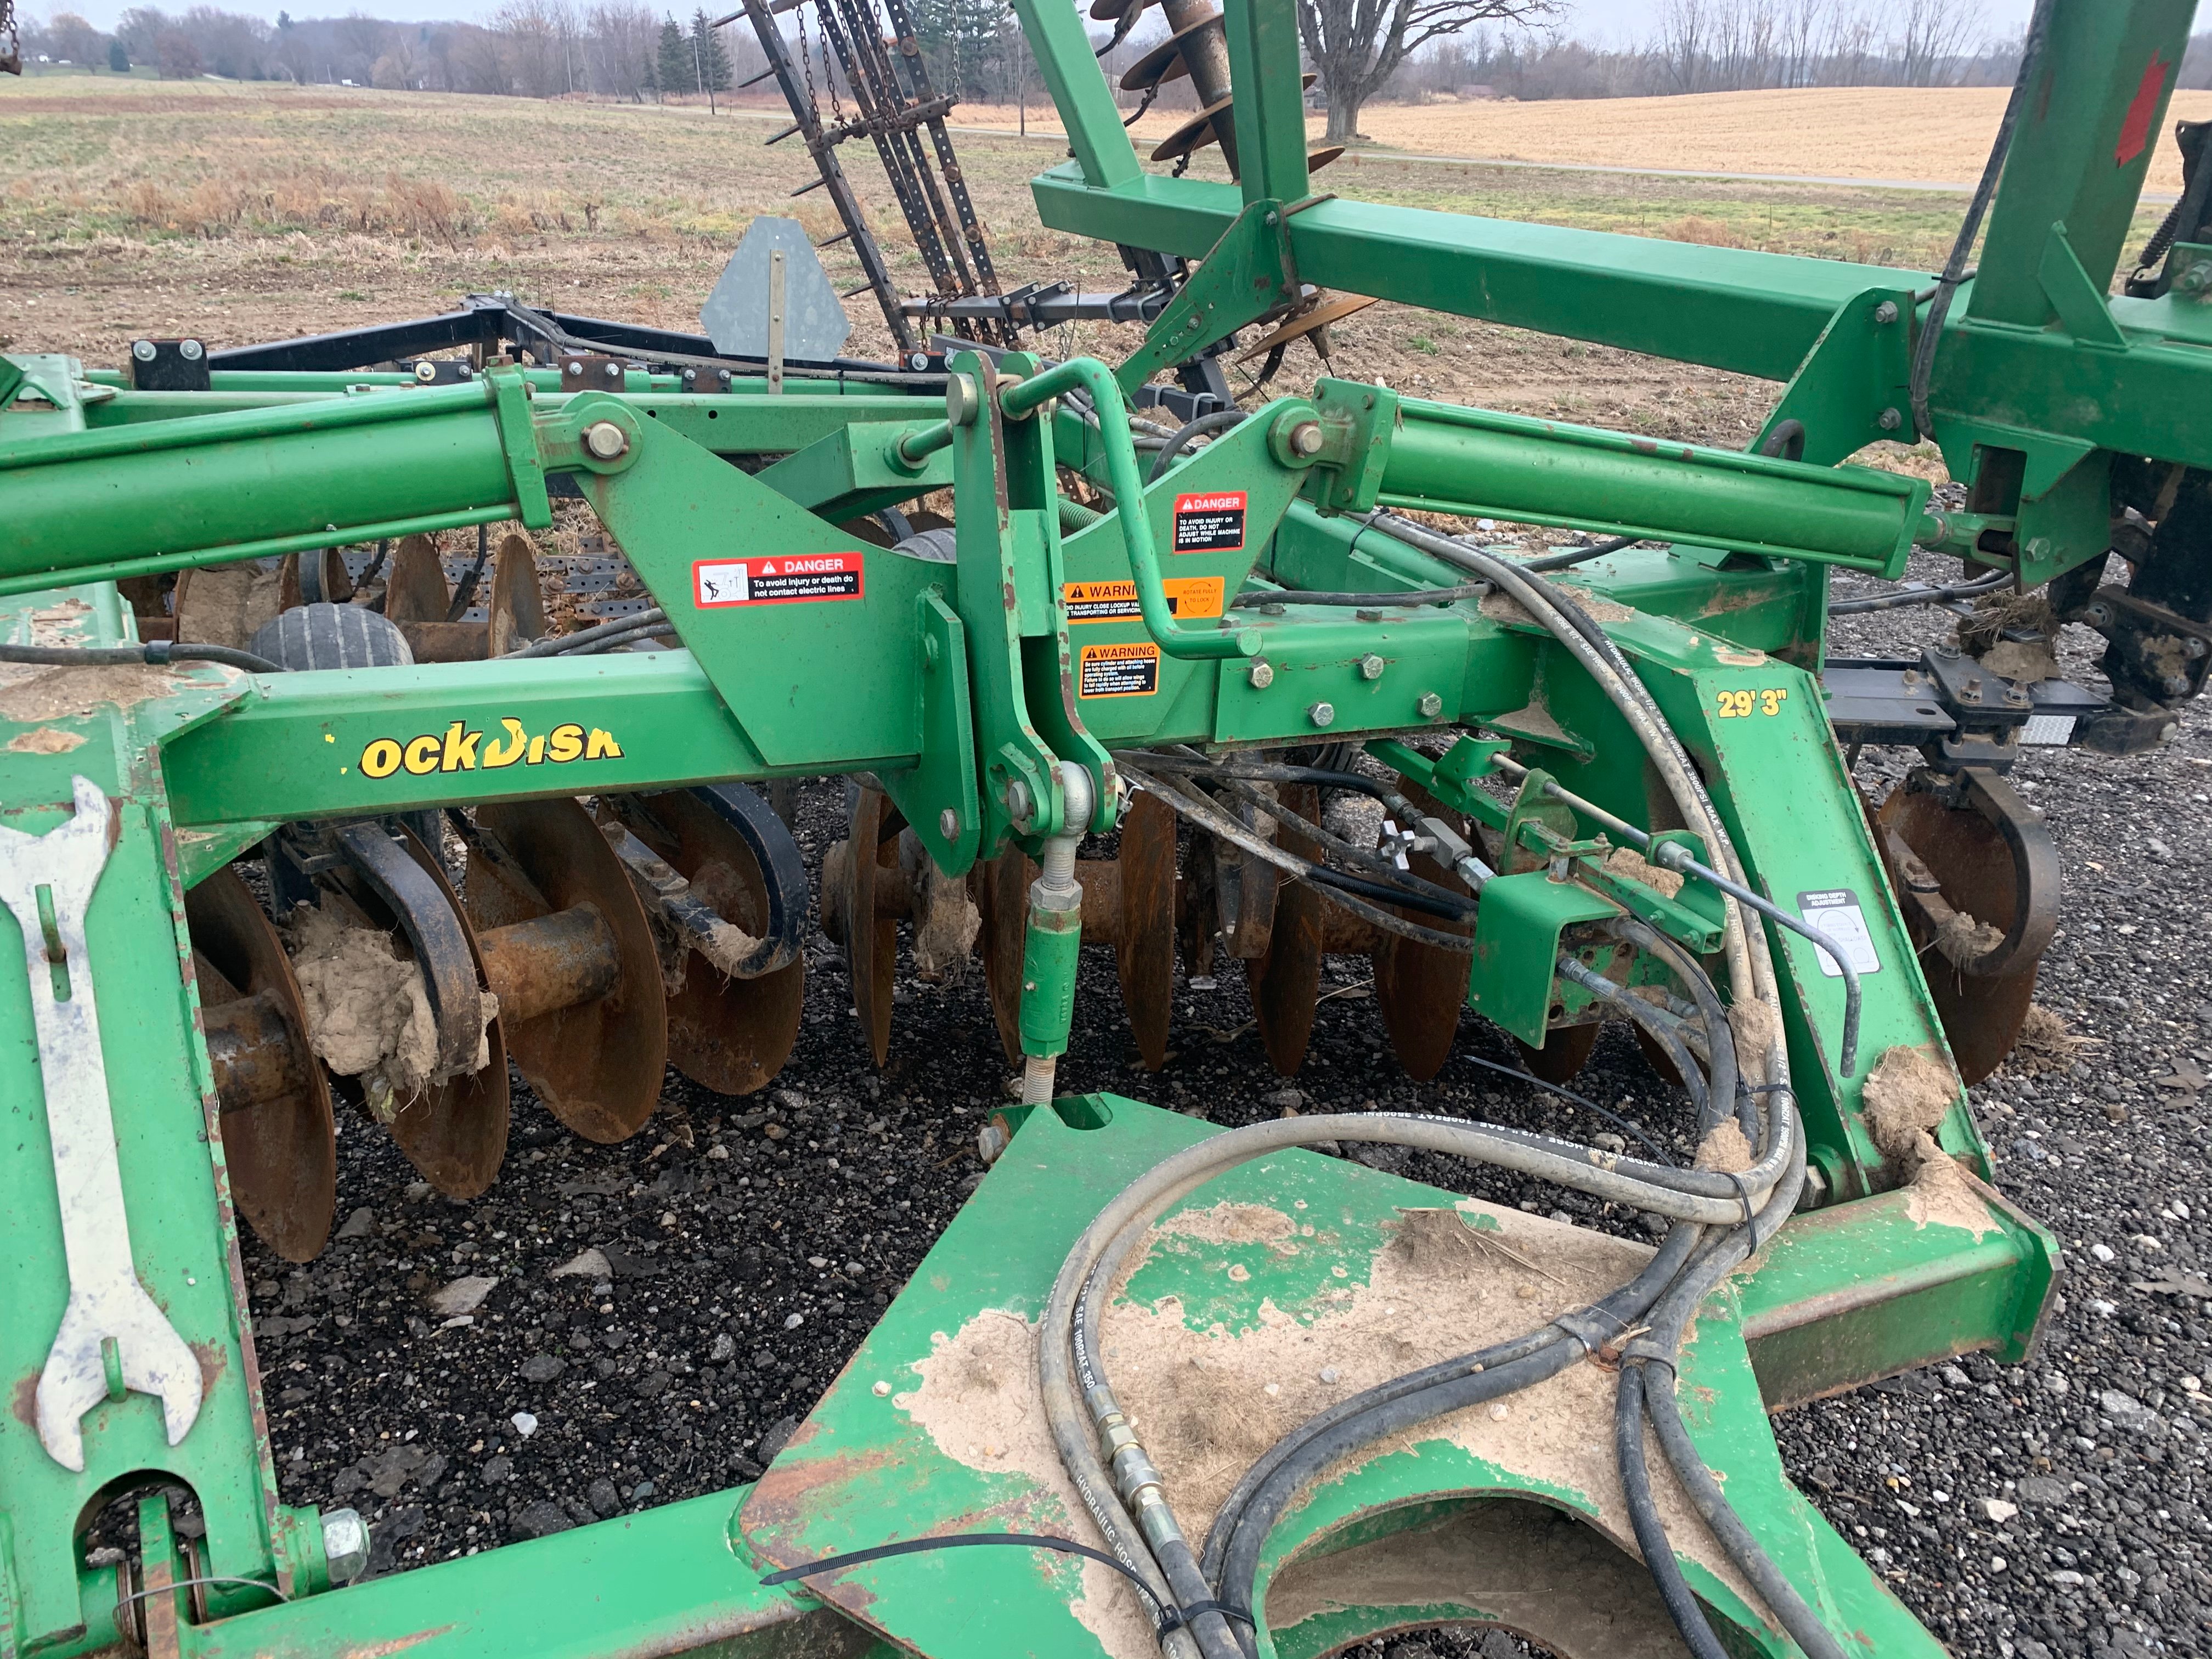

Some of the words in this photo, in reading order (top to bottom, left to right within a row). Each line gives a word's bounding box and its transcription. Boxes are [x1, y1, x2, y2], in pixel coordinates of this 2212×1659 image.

[1194, 498, 1240, 509] DANGER
[785, 558, 843, 573] DANGER
[766, 578, 786, 587] avoid
[789, 577, 810, 587] injury
[821, 576, 842, 584] death
[769, 588, 797, 596] contact
[798, 586, 826, 594] electric
[1090, 585, 1135, 597] WARNI
[1100, 646, 1155, 658] WARNING
[1554, 616, 1570, 630] HOSE
[1580, 643, 1594, 656] SAE
[1634, 709, 1650, 727] MAX
[1717, 690, 1756, 718] 29'
[1760, 689, 1787, 716] 3"
[1604, 640, 1633, 675] HYDRAULIC
[1630, 677, 1648, 696] HOSE
[1657, 718, 1671, 733] SAE
[1668, 737, 1691, 768] 100R2AT
[1688, 771, 1708, 803] 3500PSI
[1705, 805, 1719, 826] MAX
[1716, 828, 1730, 848] W.P.
[1812, 898, 1846, 906] ADJUSTMENT
[1730, 919, 1743, 947] HOSE
[1418, 1113, 1472, 1124] 100R2AT
[1480, 1122, 1505, 1131] SAE
[1549, 1137, 1583, 1150] HOSE
[1074, 1306, 1084, 1326] SAE
[1074, 1329, 1089, 1367] 100R2AT
[1076, 1474, 1115, 1543] HYDRAULIC
